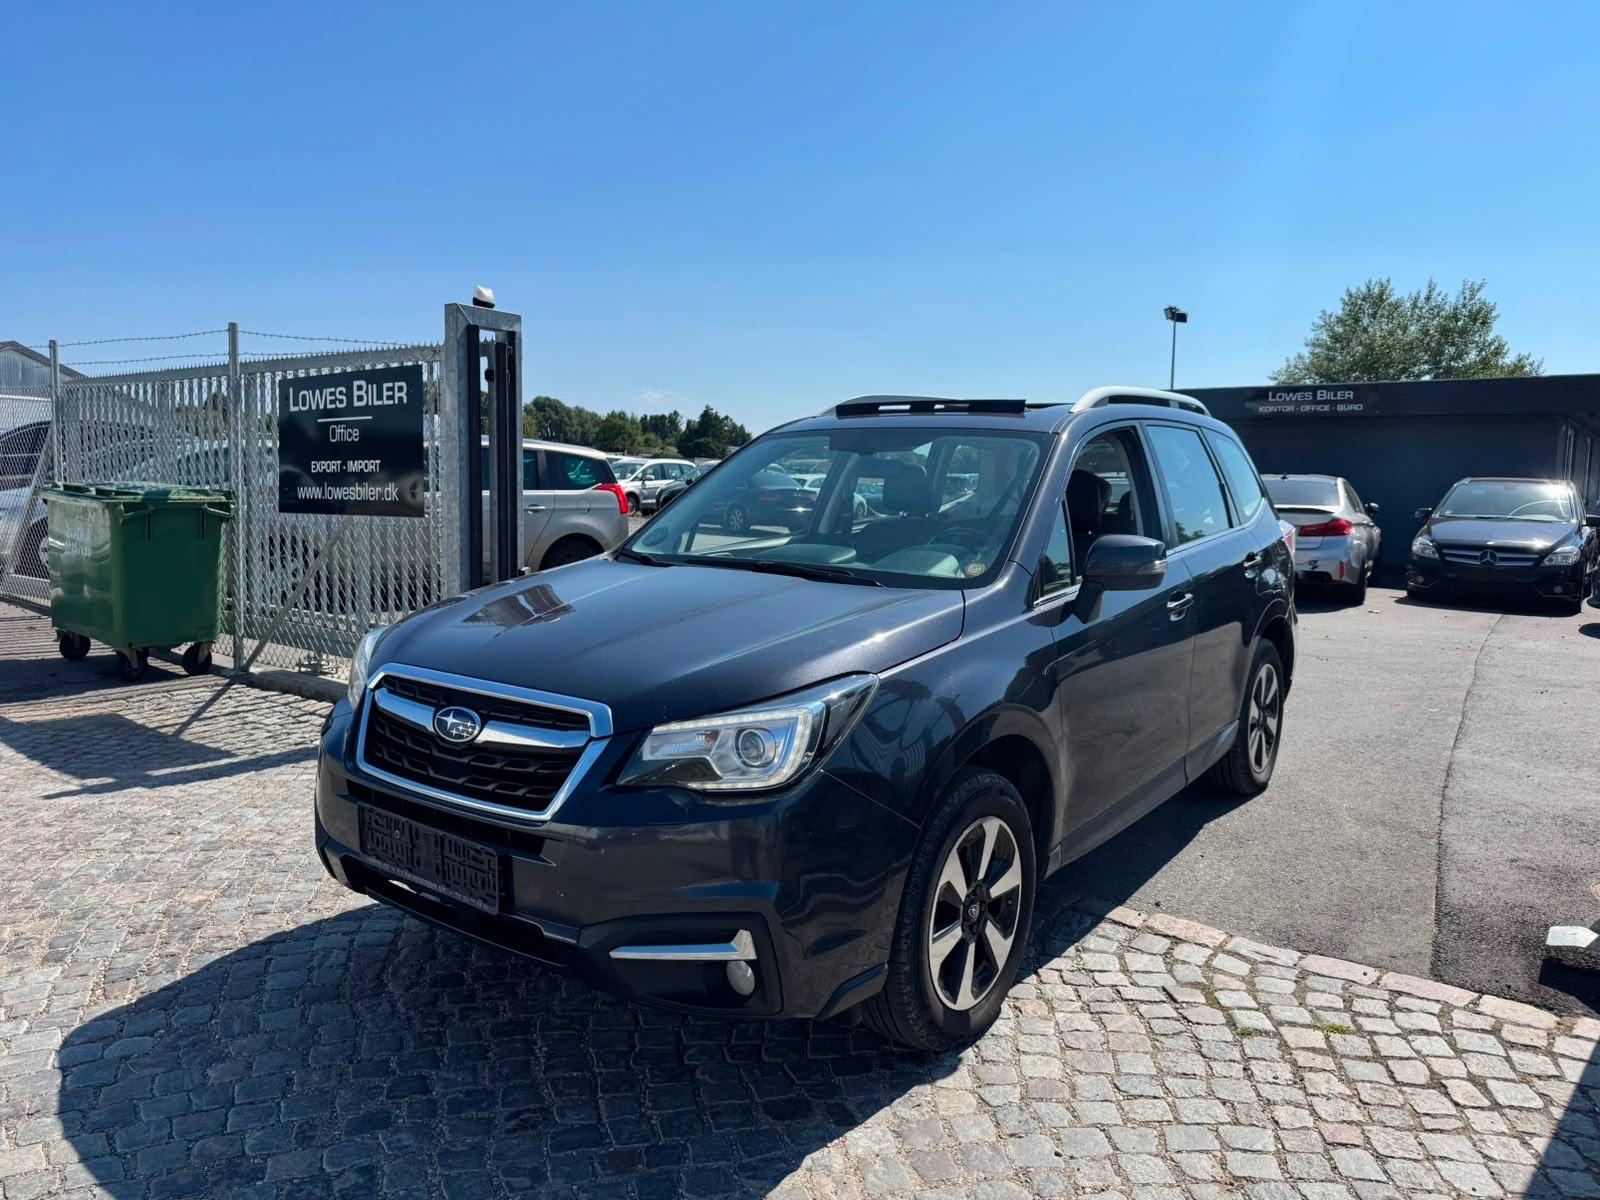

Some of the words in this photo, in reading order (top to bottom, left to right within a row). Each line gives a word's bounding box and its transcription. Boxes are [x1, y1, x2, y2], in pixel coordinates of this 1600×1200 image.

[289, 386, 347, 412] LOWES
[353, 380, 408, 407] BILER
[1268, 391, 1313, 402] LOWES
[1316, 389, 1354, 400] BILER
[1258, 405, 1295, 413] KONTOR
[1300, 404, 1330, 412] OFFICE
[1336, 403, 1363, 411] BÜRO
[329, 425, 360, 442] Office
[311, 461, 342, 473] EXPORT
[347, 460, 381, 472] IMPORT
[297, 482, 399, 501] www.lowesbiler.dk
